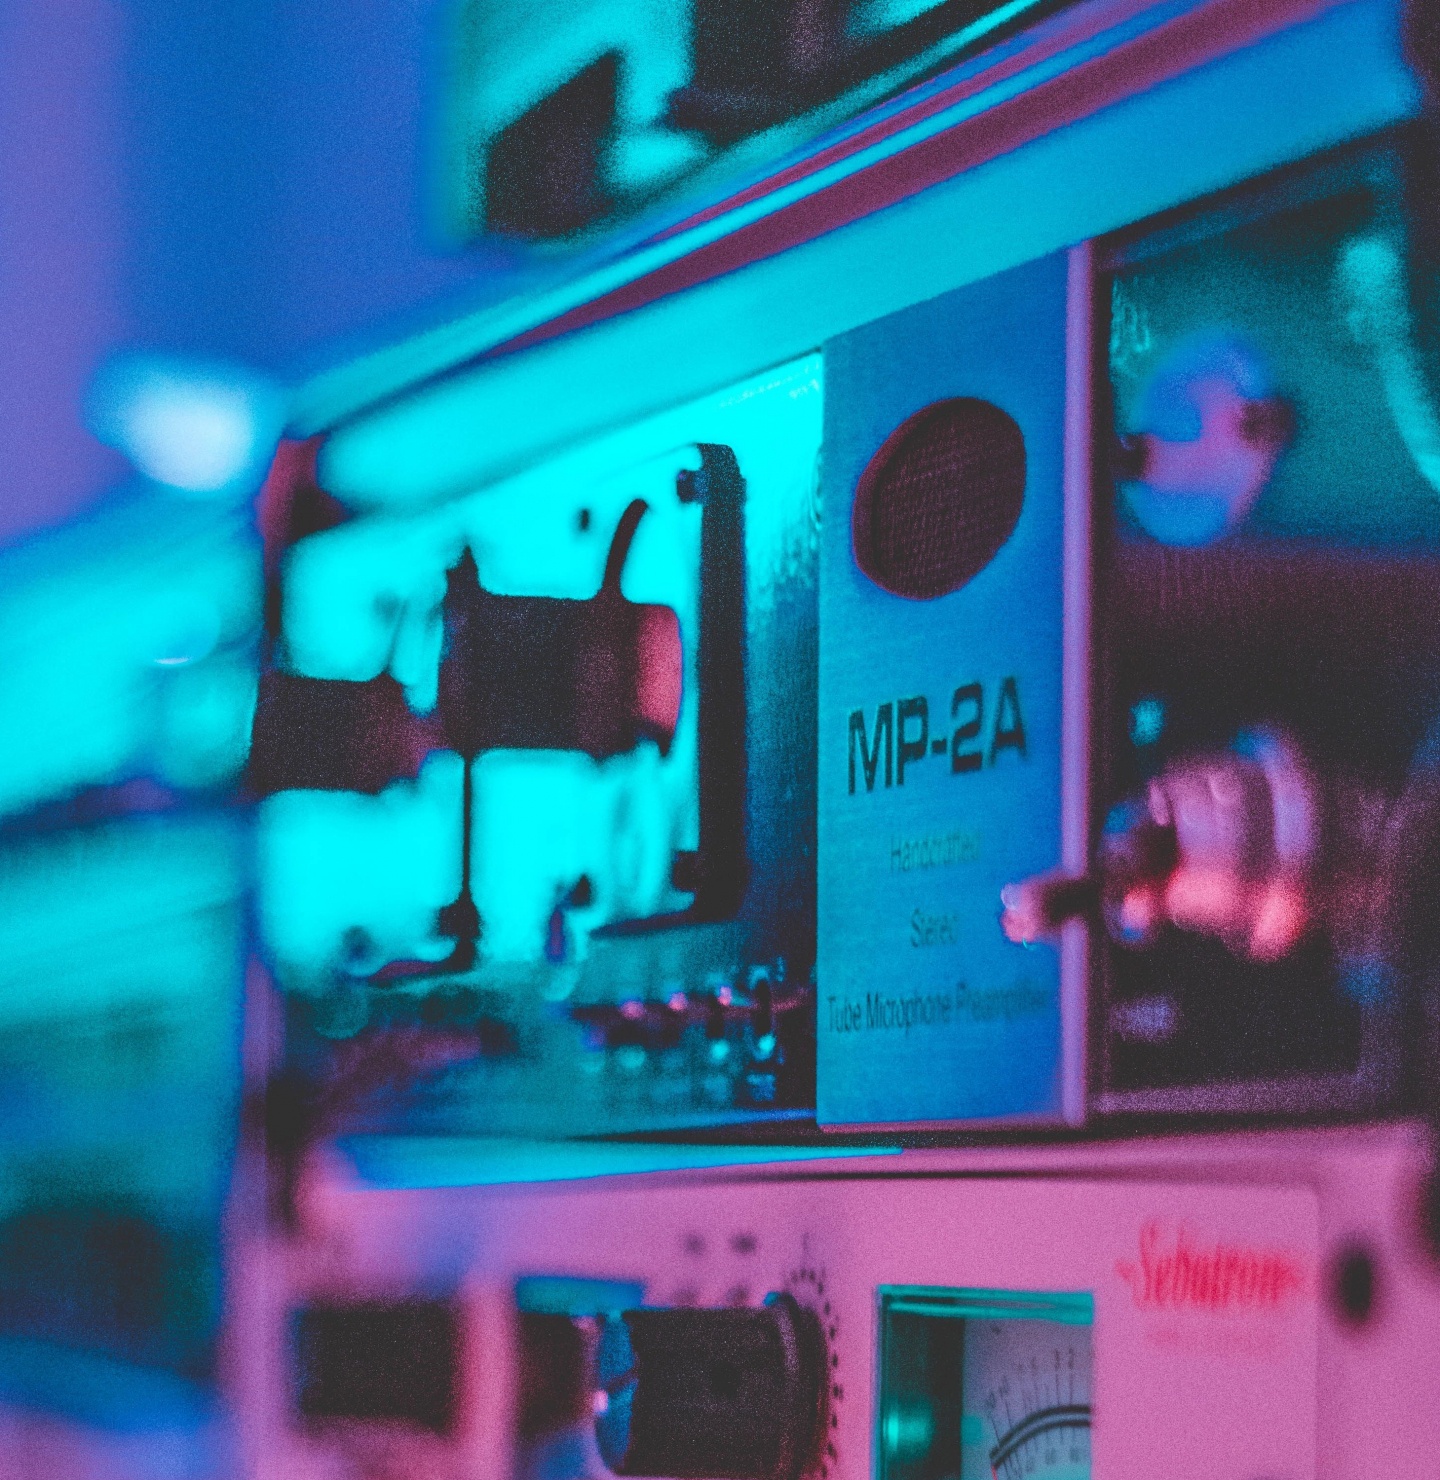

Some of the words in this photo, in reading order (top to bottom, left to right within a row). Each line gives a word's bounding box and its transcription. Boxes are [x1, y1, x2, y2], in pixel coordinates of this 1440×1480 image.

[848, 676, 1030, 796] MP-2A
[910, 907, 959, 948] Stereo
[827, 994, 862, 1033] Tube
[866, 987, 952, 1038] Microphone
